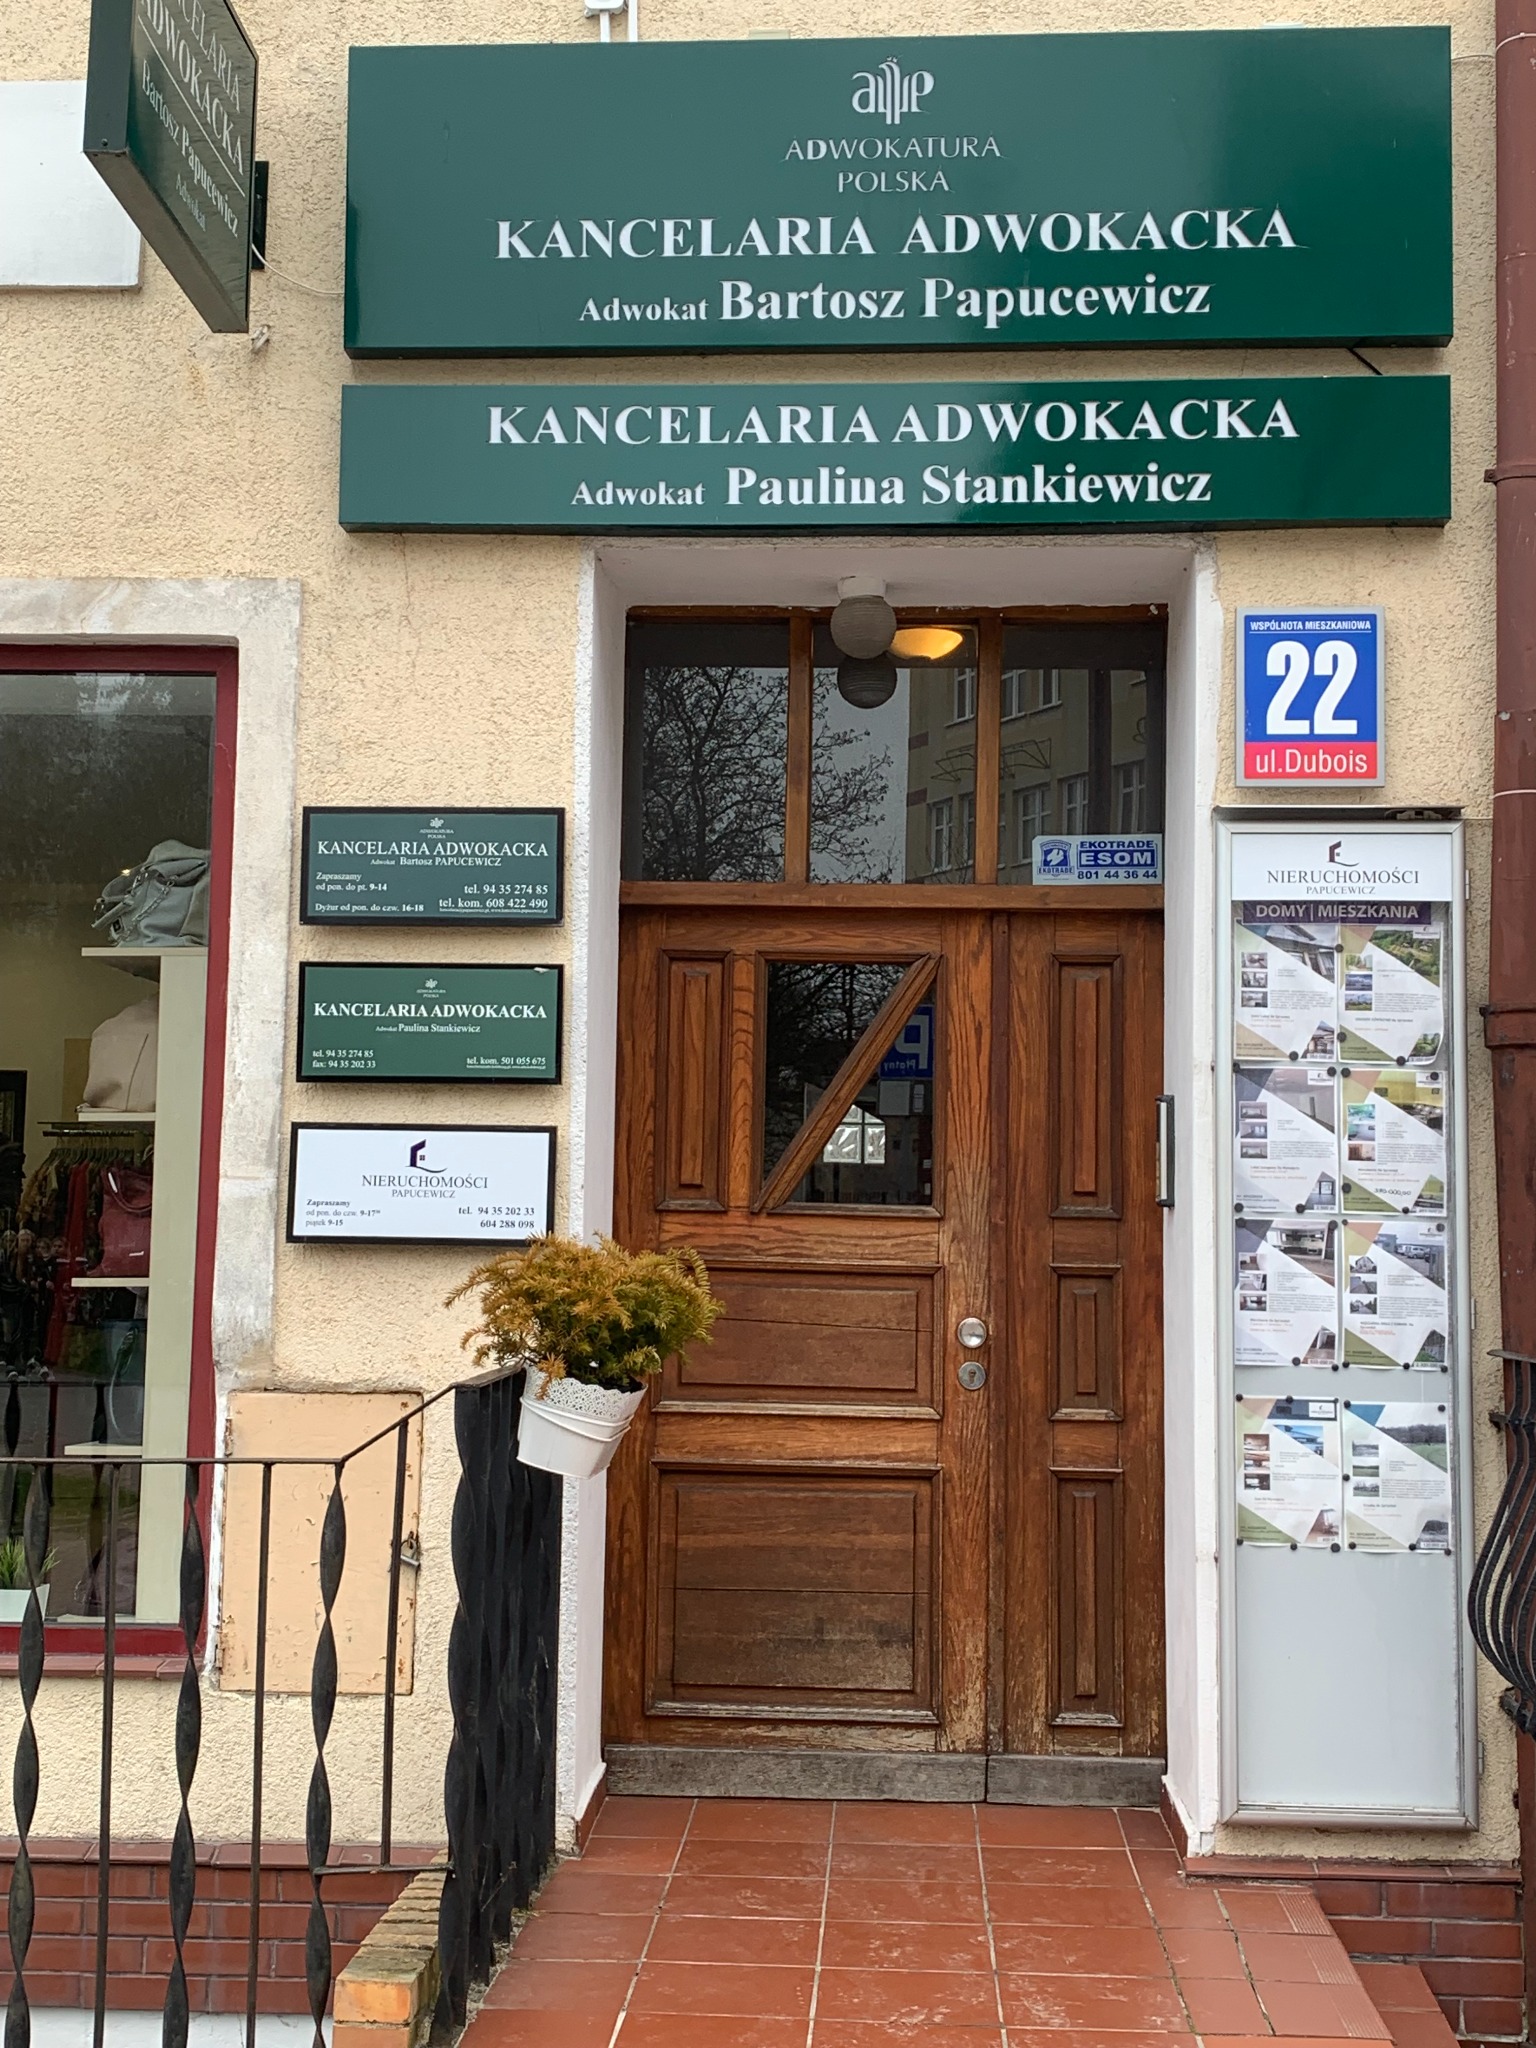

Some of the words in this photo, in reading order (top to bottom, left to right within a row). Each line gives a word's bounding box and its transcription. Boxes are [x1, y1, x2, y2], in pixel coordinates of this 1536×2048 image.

[142, 58, 179, 146] Bartosz
[182, 124, 237, 238] Papucewicz
[785, 136, 1001, 160] ADWOKATURA
[838, 169, 950, 192] POLSKA
[496, 215, 876, 259] KANCELARIA
[900, 207, 1299, 253] ADWOKACKA
[579, 297, 708, 320] Adwokat
[720, 280, 904, 320] Bartosz
[921, 273, 1213, 329] Papucewicz
[488, 405, 880, 445] KANCELARIA
[892, 398, 1299, 443] ADWOKACKA
[571, 481, 705, 506] Adwokat
[725, 467, 905, 505] Paulina
[922, 463, 1212, 505] Stankiewicz
[1250, 619, 1303, 631] WSPÓLNOTA
[1305, 620, 1371, 630] MIESZKANIOWA
[1266, 640, 1358, 735] 22
[1256, 749, 1368, 773] ul.Dubois
[318, 841, 430, 855] KANCELARIA
[434, 842, 548, 857] ADWOKACKA
[1080, 840, 1154, 849] EKOTRADE
[400, 857, 432, 866] Bartosz
[435, 857, 501, 867] PAPUCEWICZ
[1080, 852, 1151, 865] ESOM
[1038, 866, 1073, 874] EKOTRADE
[1078, 871, 1099, 879] 801
[1104, 870, 1120, 879] 44
[1124, 870, 1139, 879] 36
[1142, 870, 1158, 879] 44
[316, 872, 361, 882] Zapraszamy
[1267, 867, 1419, 884] NIERUCHOMOŚCI
[316, 883, 325, 891] od
[346, 883, 355, 891] do
[369, 883, 387, 892] 9-14
[464, 884, 480, 894] tel.
[483, 884, 496, 894] 94
[498, 884, 511, 894] 35
[514, 885, 533, 894] 274
[535, 885, 548, 894] 85
[1306, 886, 1376, 895] PAPUCEWICZ
[315, 903, 339, 913] Dyżur
[341, 903, 350, 912] od
[370, 903, 380, 912] do
[401, 904, 424, 912] 16-18
[439, 898, 455, 908] tel.
[458, 898, 483, 908] kom.
[486, 898, 505, 908] 608
[507, 898, 526, 908] 422
[529, 898, 548, 908] 490
[1256, 904, 1306, 918] DOMY
[1318, 904, 1418, 919] MIESZKANIA
[314, 1003, 428, 1017] KANCELARIA
[431, 1004, 547, 1019] ADWOKACKA
[398, 1023, 429, 1033] Paulina
[431, 1023, 481, 1033] Stankiewicz
[312, 1050, 324, 1058] tel.
[325, 1050, 336, 1058] 94
[337, 1050, 347, 1058] 35
[348, 1050, 362, 1058] 274
[363, 1050, 374, 1058] 85
[312, 1060, 327, 1068] fax:
[328, 1060, 338, 1068] 94
[339, 1060, 349, 1068] 35
[351, 1060, 365, 1068] 202
[366, 1060, 376, 1068] 33
[467, 1057, 478, 1065] tel.
[480, 1057, 499, 1065] kom.
[501, 1057, 514, 1065] 501
[516, 1057, 531, 1065] 055
[532, 1057, 546, 1065] 675
[362, 1174, 488, 1189] NIERUCHOMOŚCI
[391, 1189, 456, 1198] PAPUCEWICZ
[306, 1199, 351, 1208] Zapraszamy
[306, 1209, 316, 1217] od
[333, 1209, 341, 1217] do
[458, 1206, 473, 1215] tel.
[478, 1206, 489, 1215] 94
[491, 1206, 503, 1215] 35
[505, 1207, 521, 1216] 202
[523, 1207, 535, 1216] 33
[480, 1219, 496, 1228] 604
[499, 1220, 516, 1229] 288
[518, 1220, 535, 1229] 098
